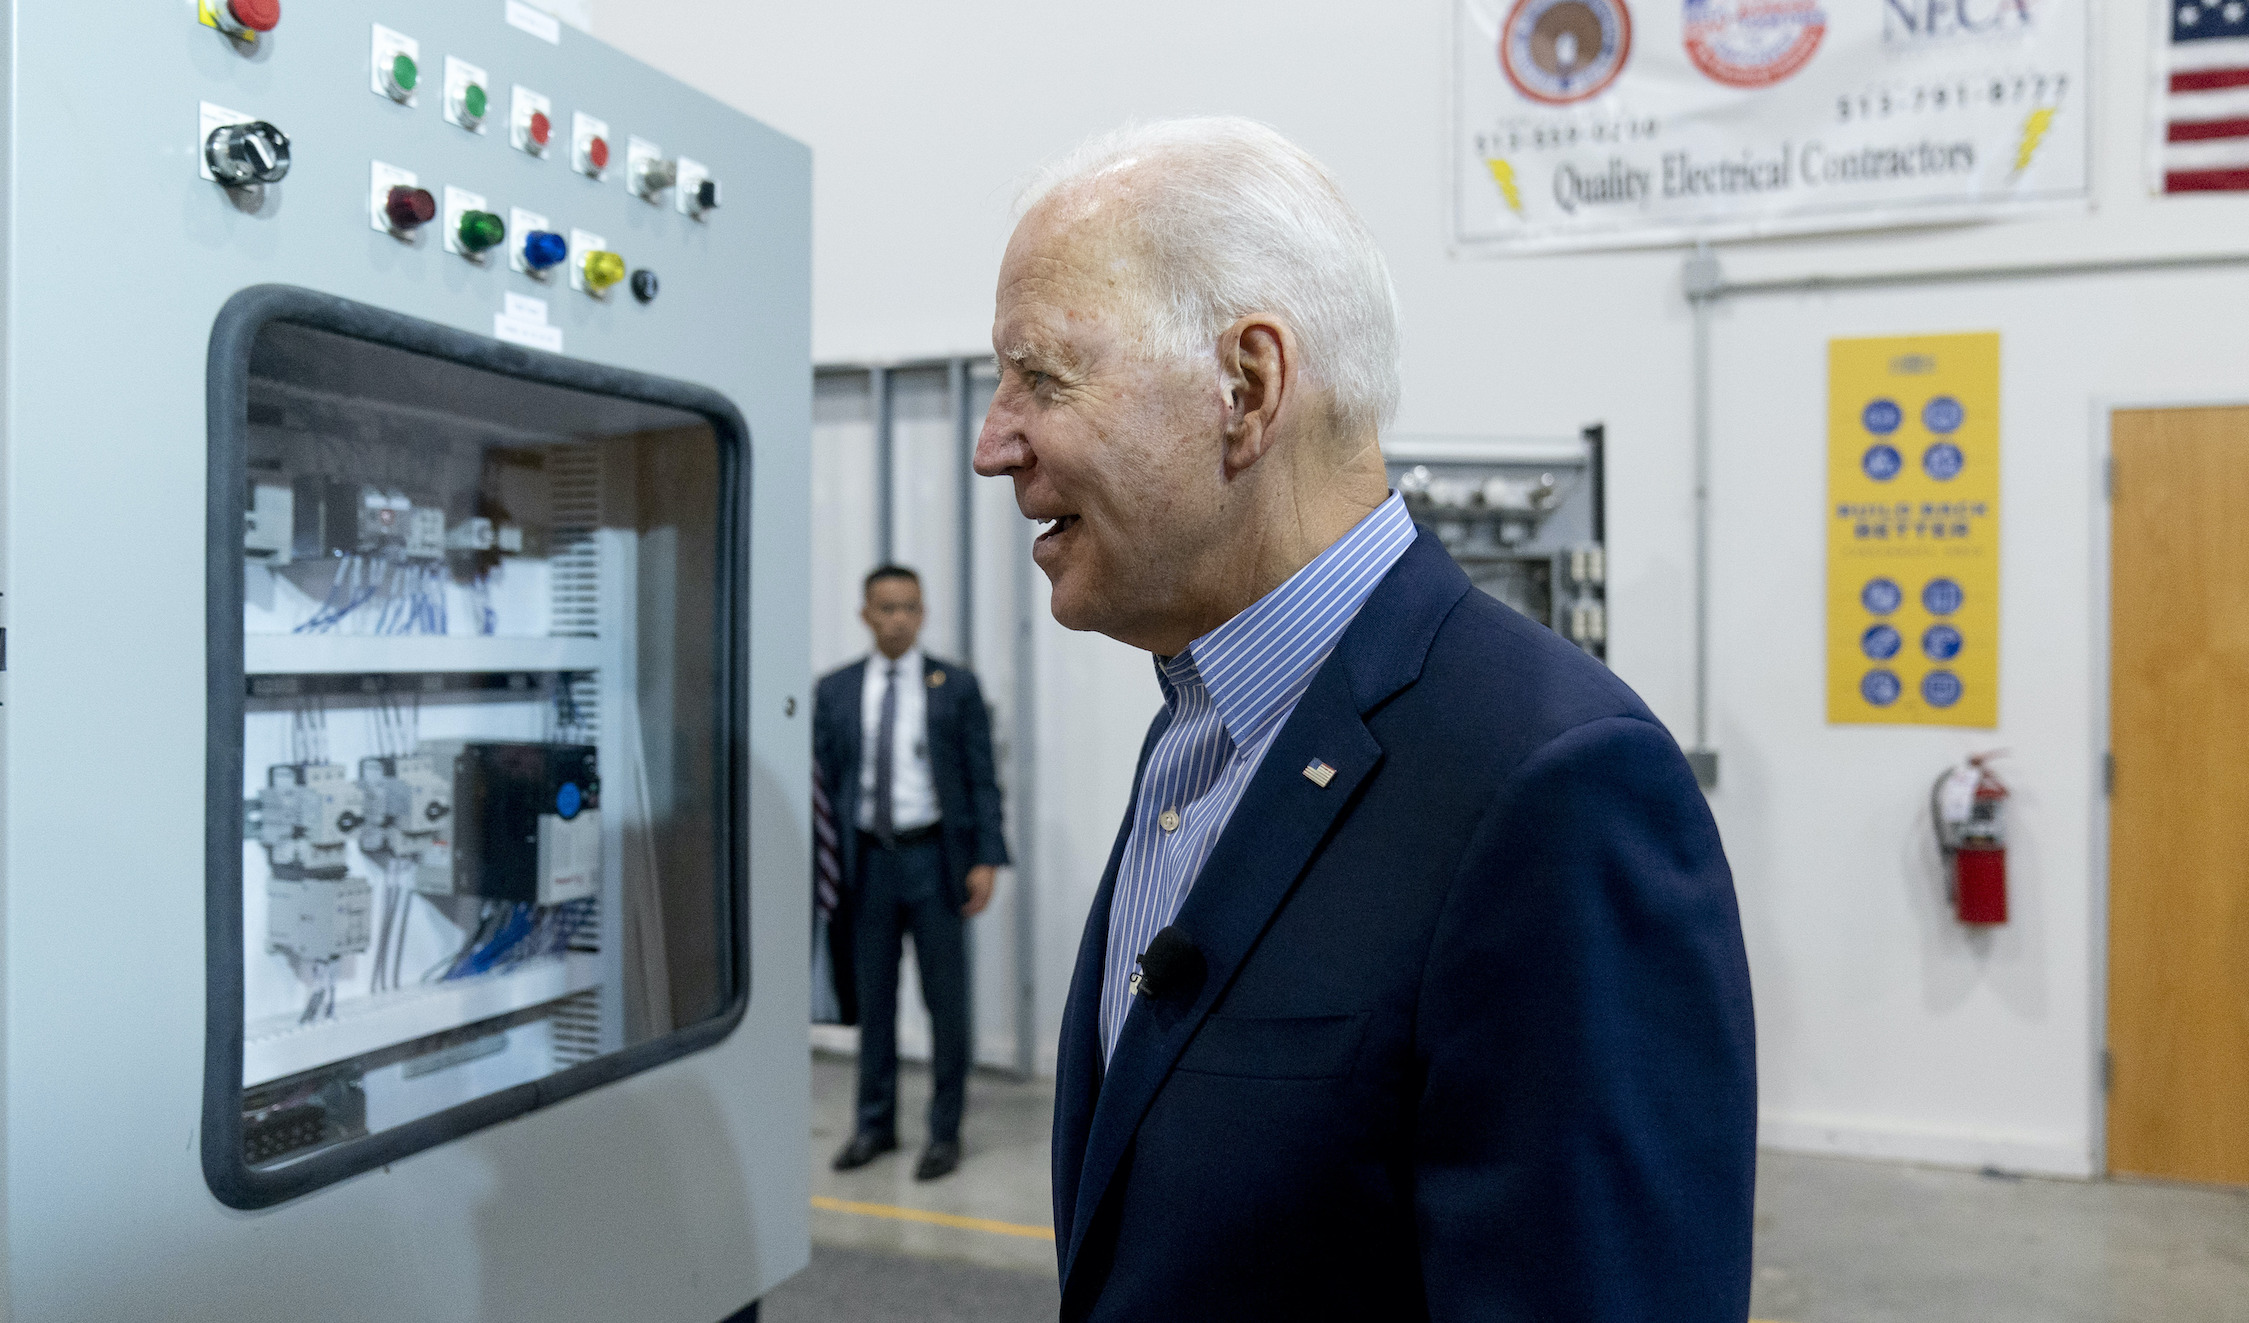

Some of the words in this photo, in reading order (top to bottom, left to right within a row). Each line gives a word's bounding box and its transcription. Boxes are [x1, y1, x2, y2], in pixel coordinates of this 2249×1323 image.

[1553, 157, 1650, 215] Quality
[1661, 141, 1790, 198] Electrical
[1800, 137, 1975, 187] Contractors
